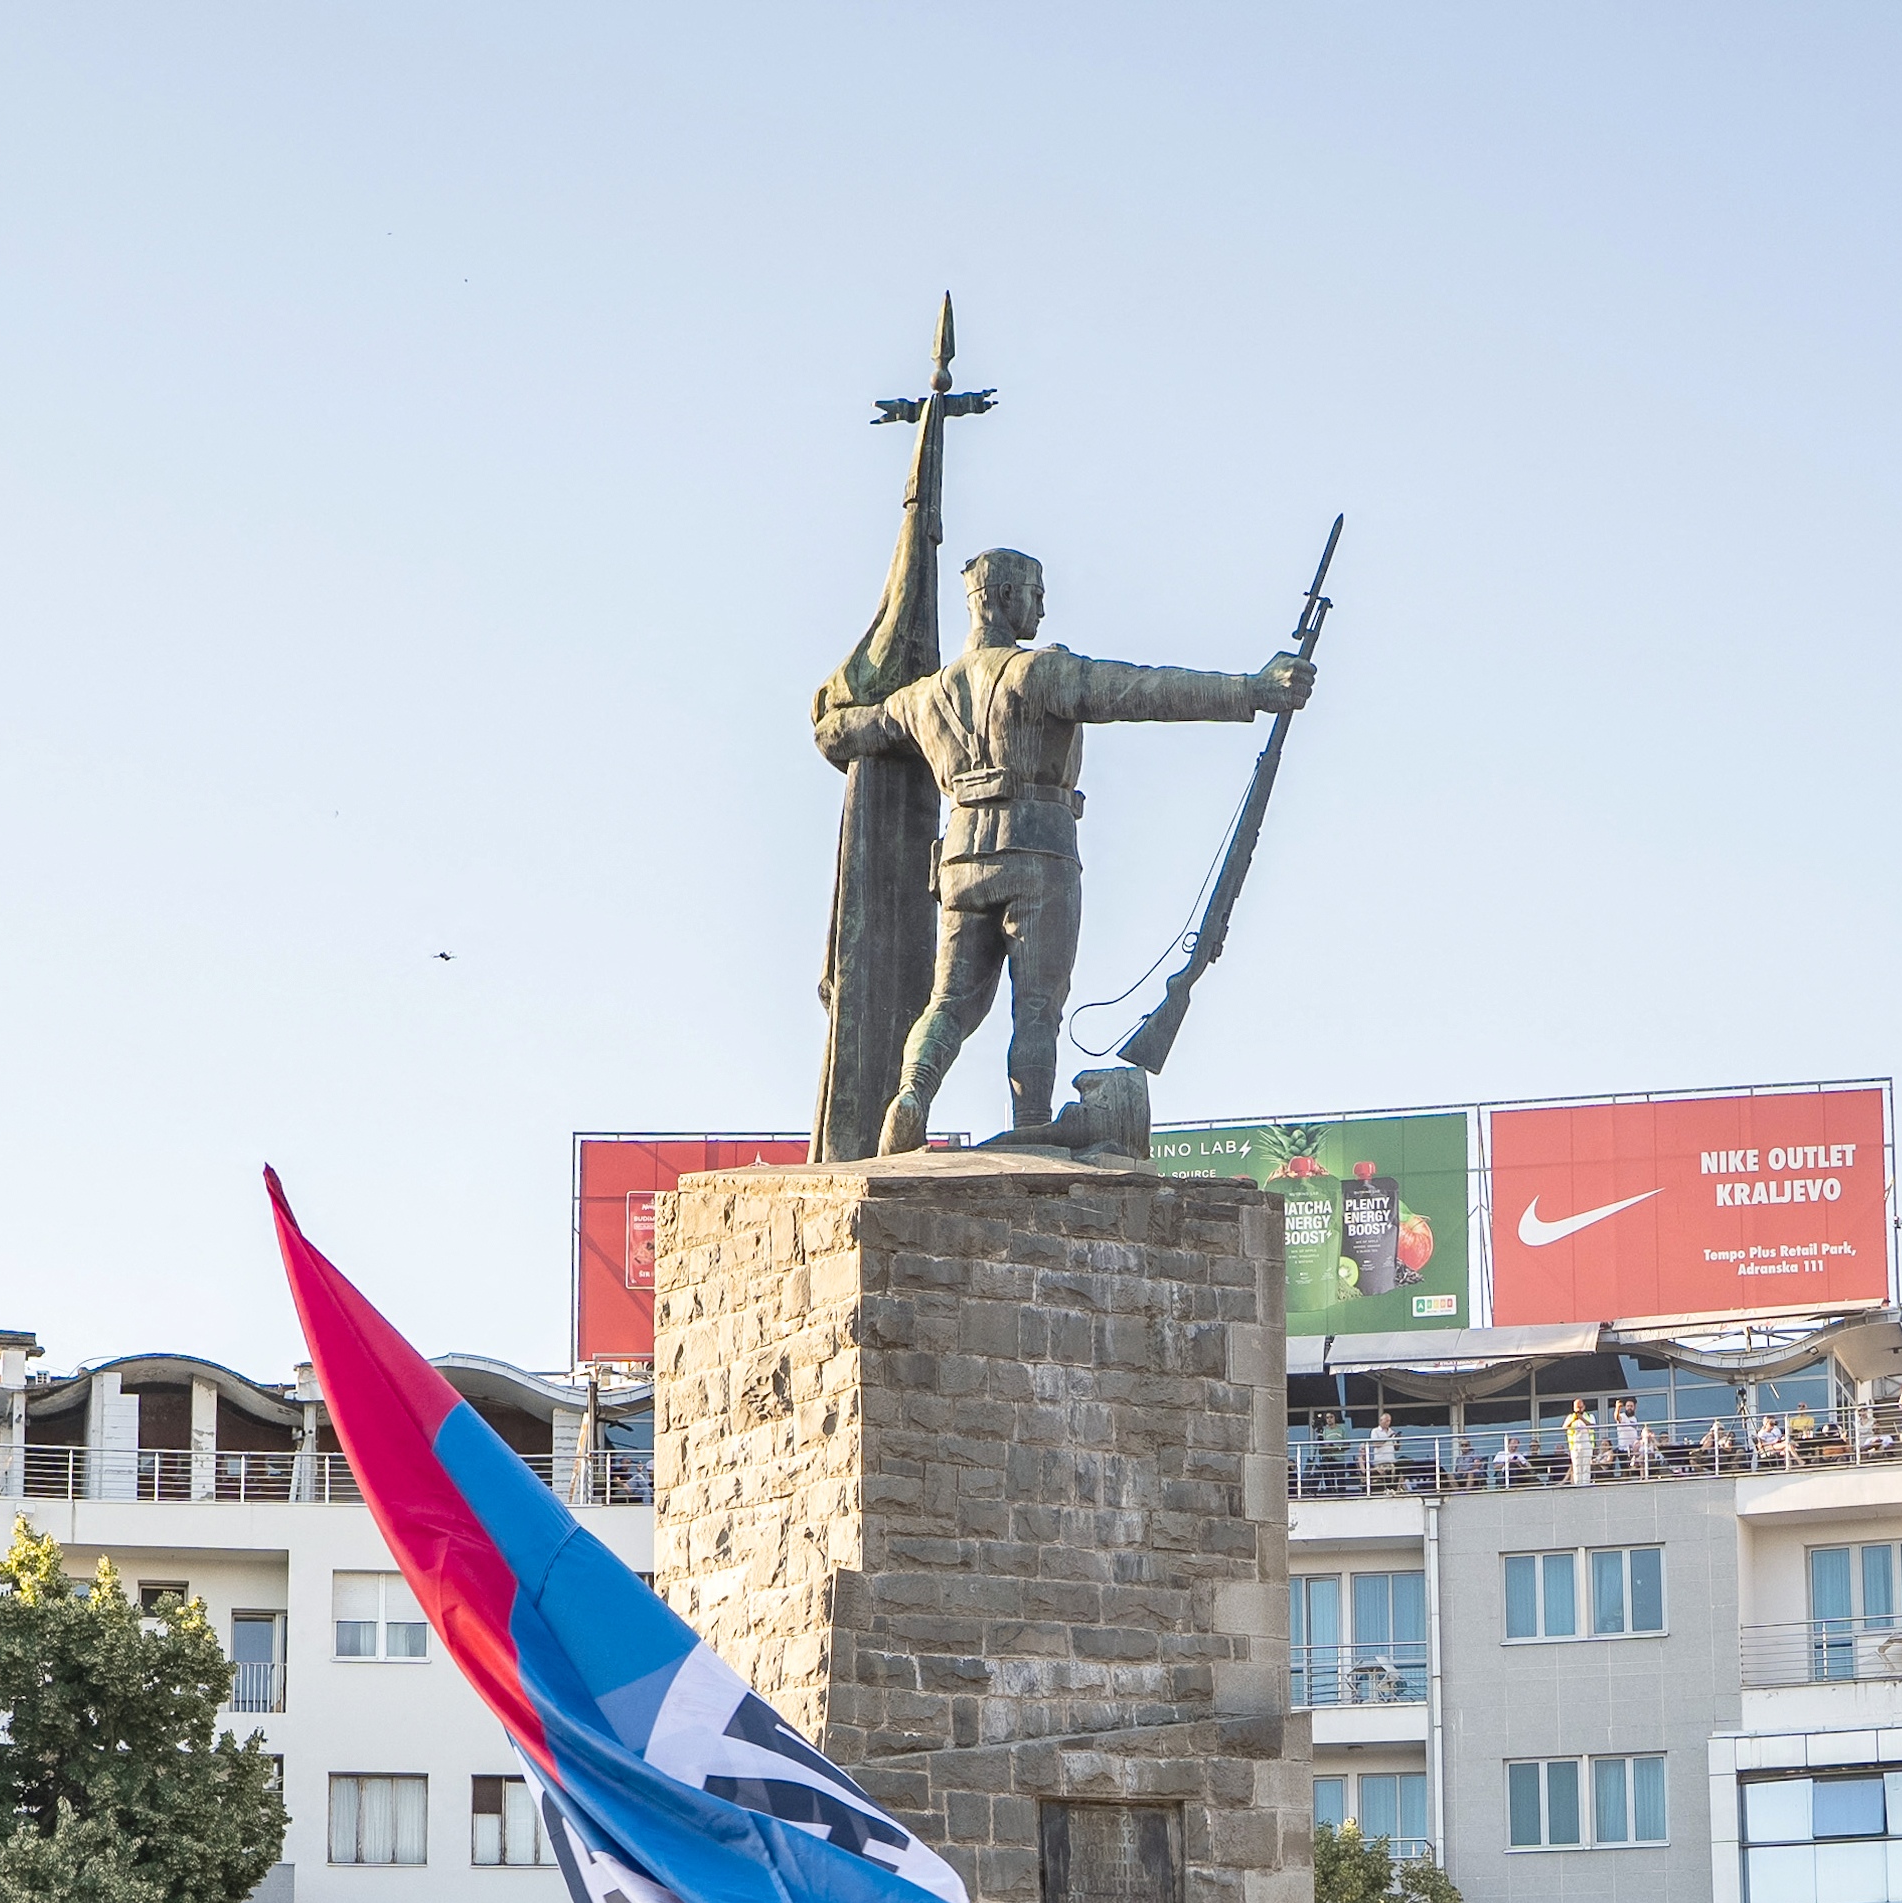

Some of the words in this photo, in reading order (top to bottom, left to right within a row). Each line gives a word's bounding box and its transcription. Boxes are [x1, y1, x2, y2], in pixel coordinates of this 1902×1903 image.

[1200, 1140, 1237, 1156] LAB
[1700, 1149, 1759, 1174] NIKE
[1768, 1144, 1856, 1170] OUTLET
[1716, 1177, 1842, 1207] KRALJEVO
[1345, 1196, 1390, 1212] PLENTY
[1284, 1215, 1331, 1232] NERGY
[1344, 1209, 1391, 1225] ENERGY
[1348, 1221, 1387, 1237] BOOST
[1704, 1249, 1746, 1262] Tempo
[1749, 1246, 1777, 1259] Plus
[1780, 1243, 1818, 1257] Retail
[1821, 1241, 1857, 1256] Park,
[1738, 1261, 1799, 1276] Adranska
[1803, 1260, 1824, 1272] 111
